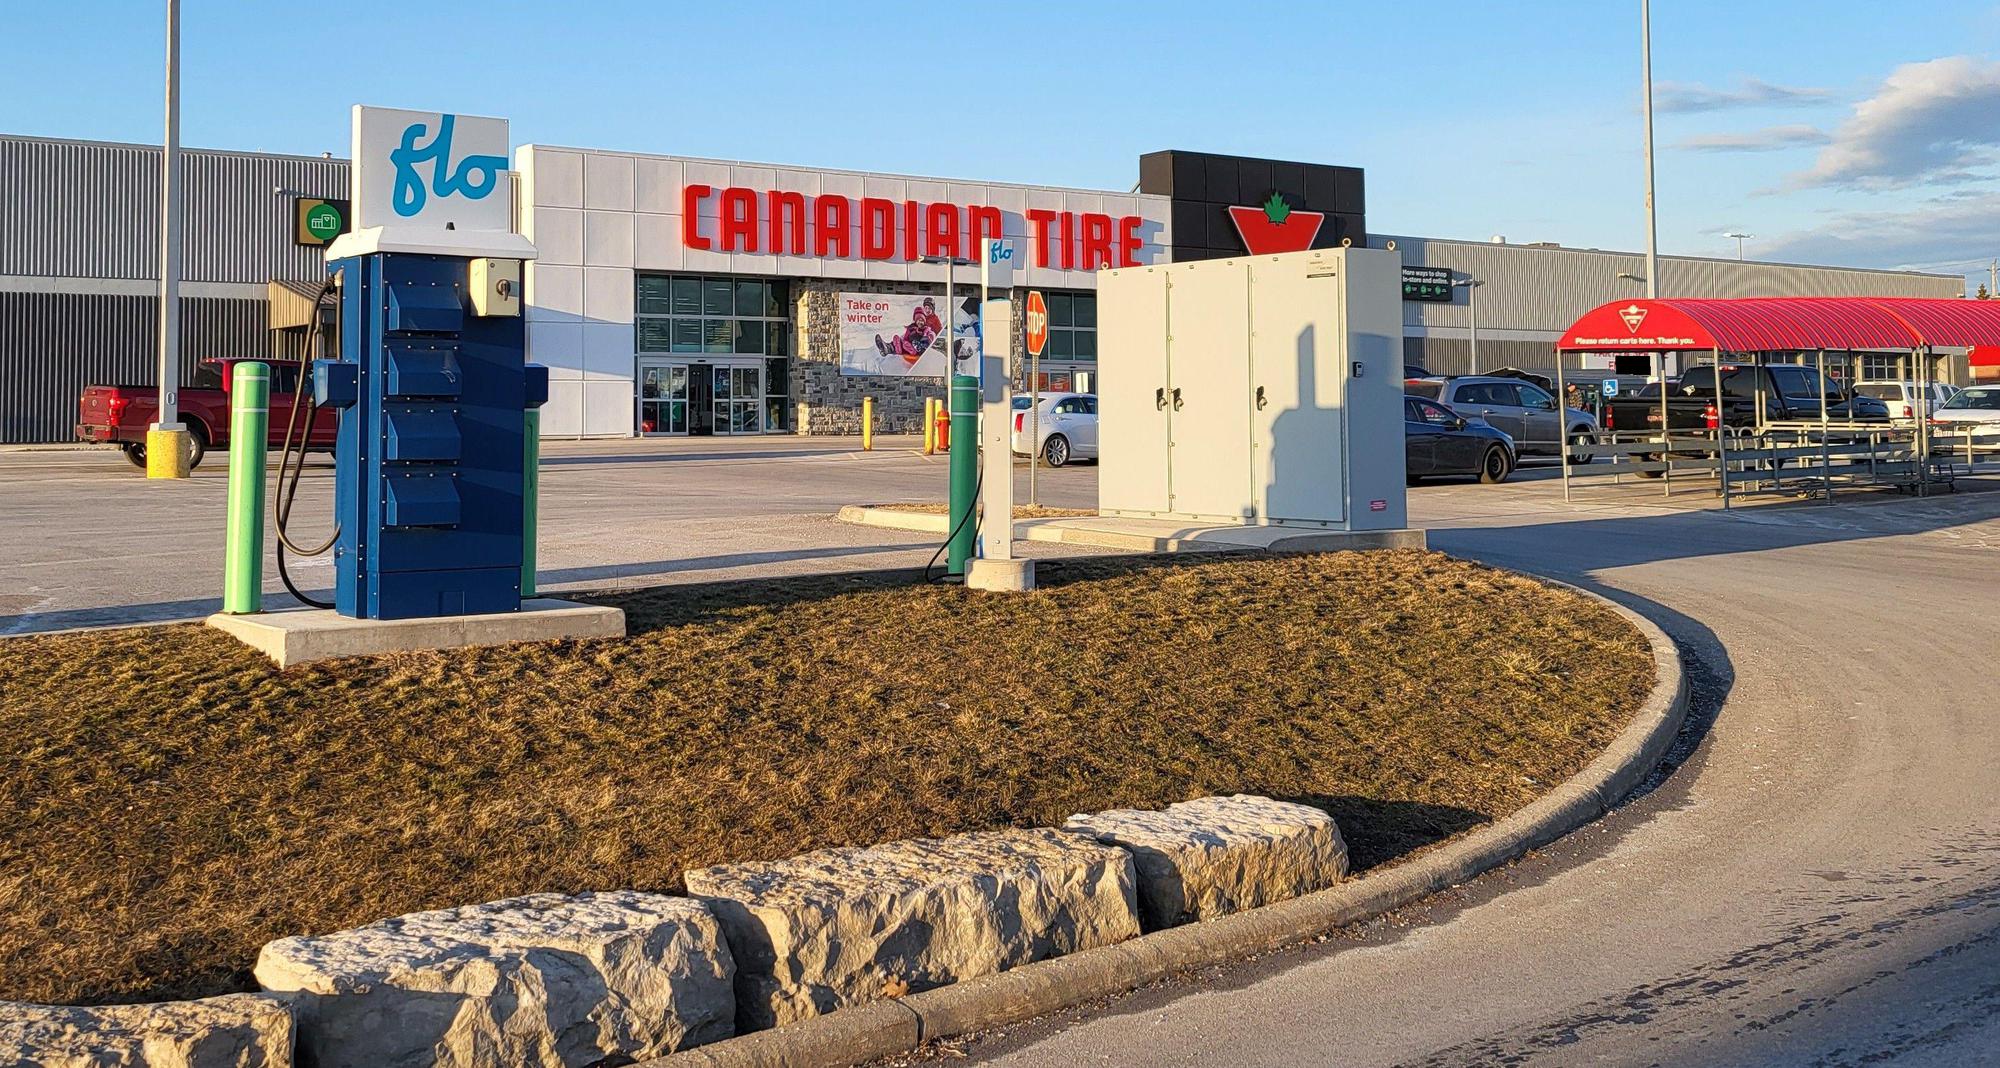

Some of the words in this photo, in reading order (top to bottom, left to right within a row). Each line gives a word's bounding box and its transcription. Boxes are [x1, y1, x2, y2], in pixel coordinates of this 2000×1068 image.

[390, 114, 509, 217] flo
[683, 184, 1003, 265] CANADIAN
[1026, 208, 1144, 271] TIRE
[991, 240, 1013, 264] flo
[847, 300, 871, 311] Take
[875, 302, 889, 311] on
[847, 312, 883, 324] winter
[1575, 337, 1598, 345] Please
[1598, 337, 1618, 345] return
[1619, 337, 1638, 345] carts
[1638, 337, 1656, 345] here.
[1657, 336, 1679, 345] Thank
[1679, 338, 1696, 346] you.
